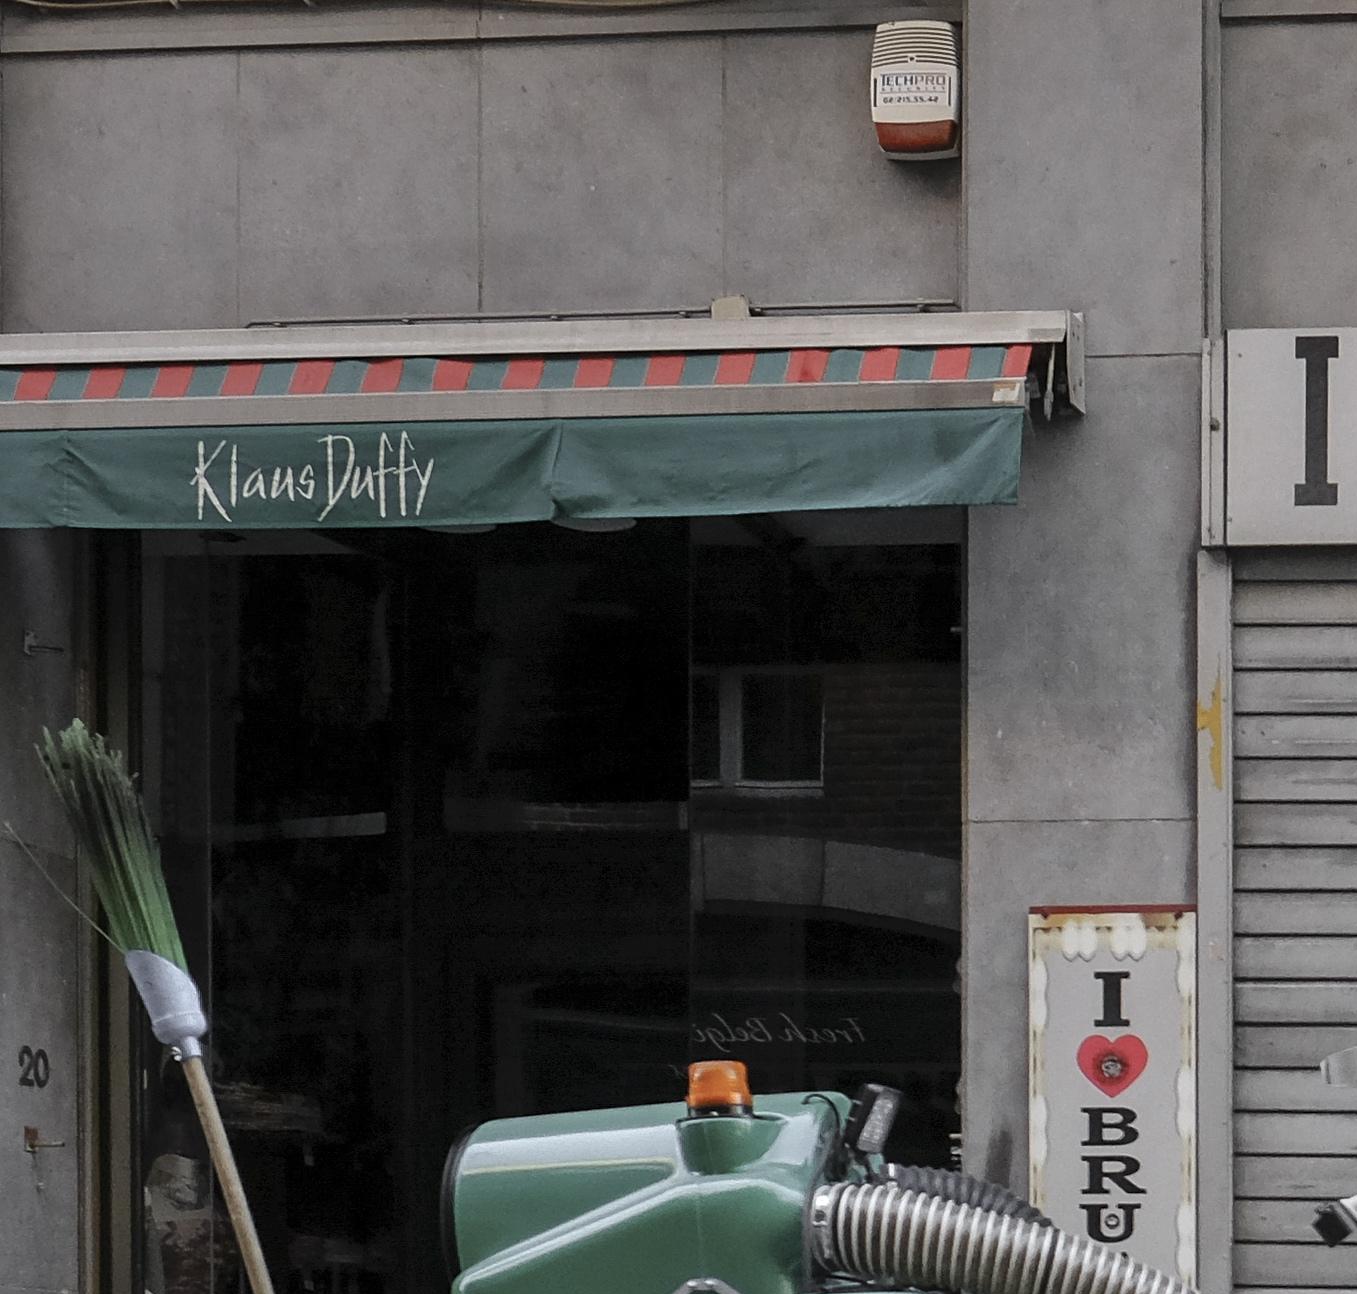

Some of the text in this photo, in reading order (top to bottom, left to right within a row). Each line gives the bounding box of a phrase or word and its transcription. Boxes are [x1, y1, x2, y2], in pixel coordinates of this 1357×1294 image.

[880, 73, 946, 86] TECHPRO
[1294, 336, 1339, 506] I
[190, 430, 434, 522] Klaus Duffy
[1094, 971, 1131, 1027] I
[18, 1045, 49, 1088] 20
[1079, 1107, 1147, 1253] BRU
